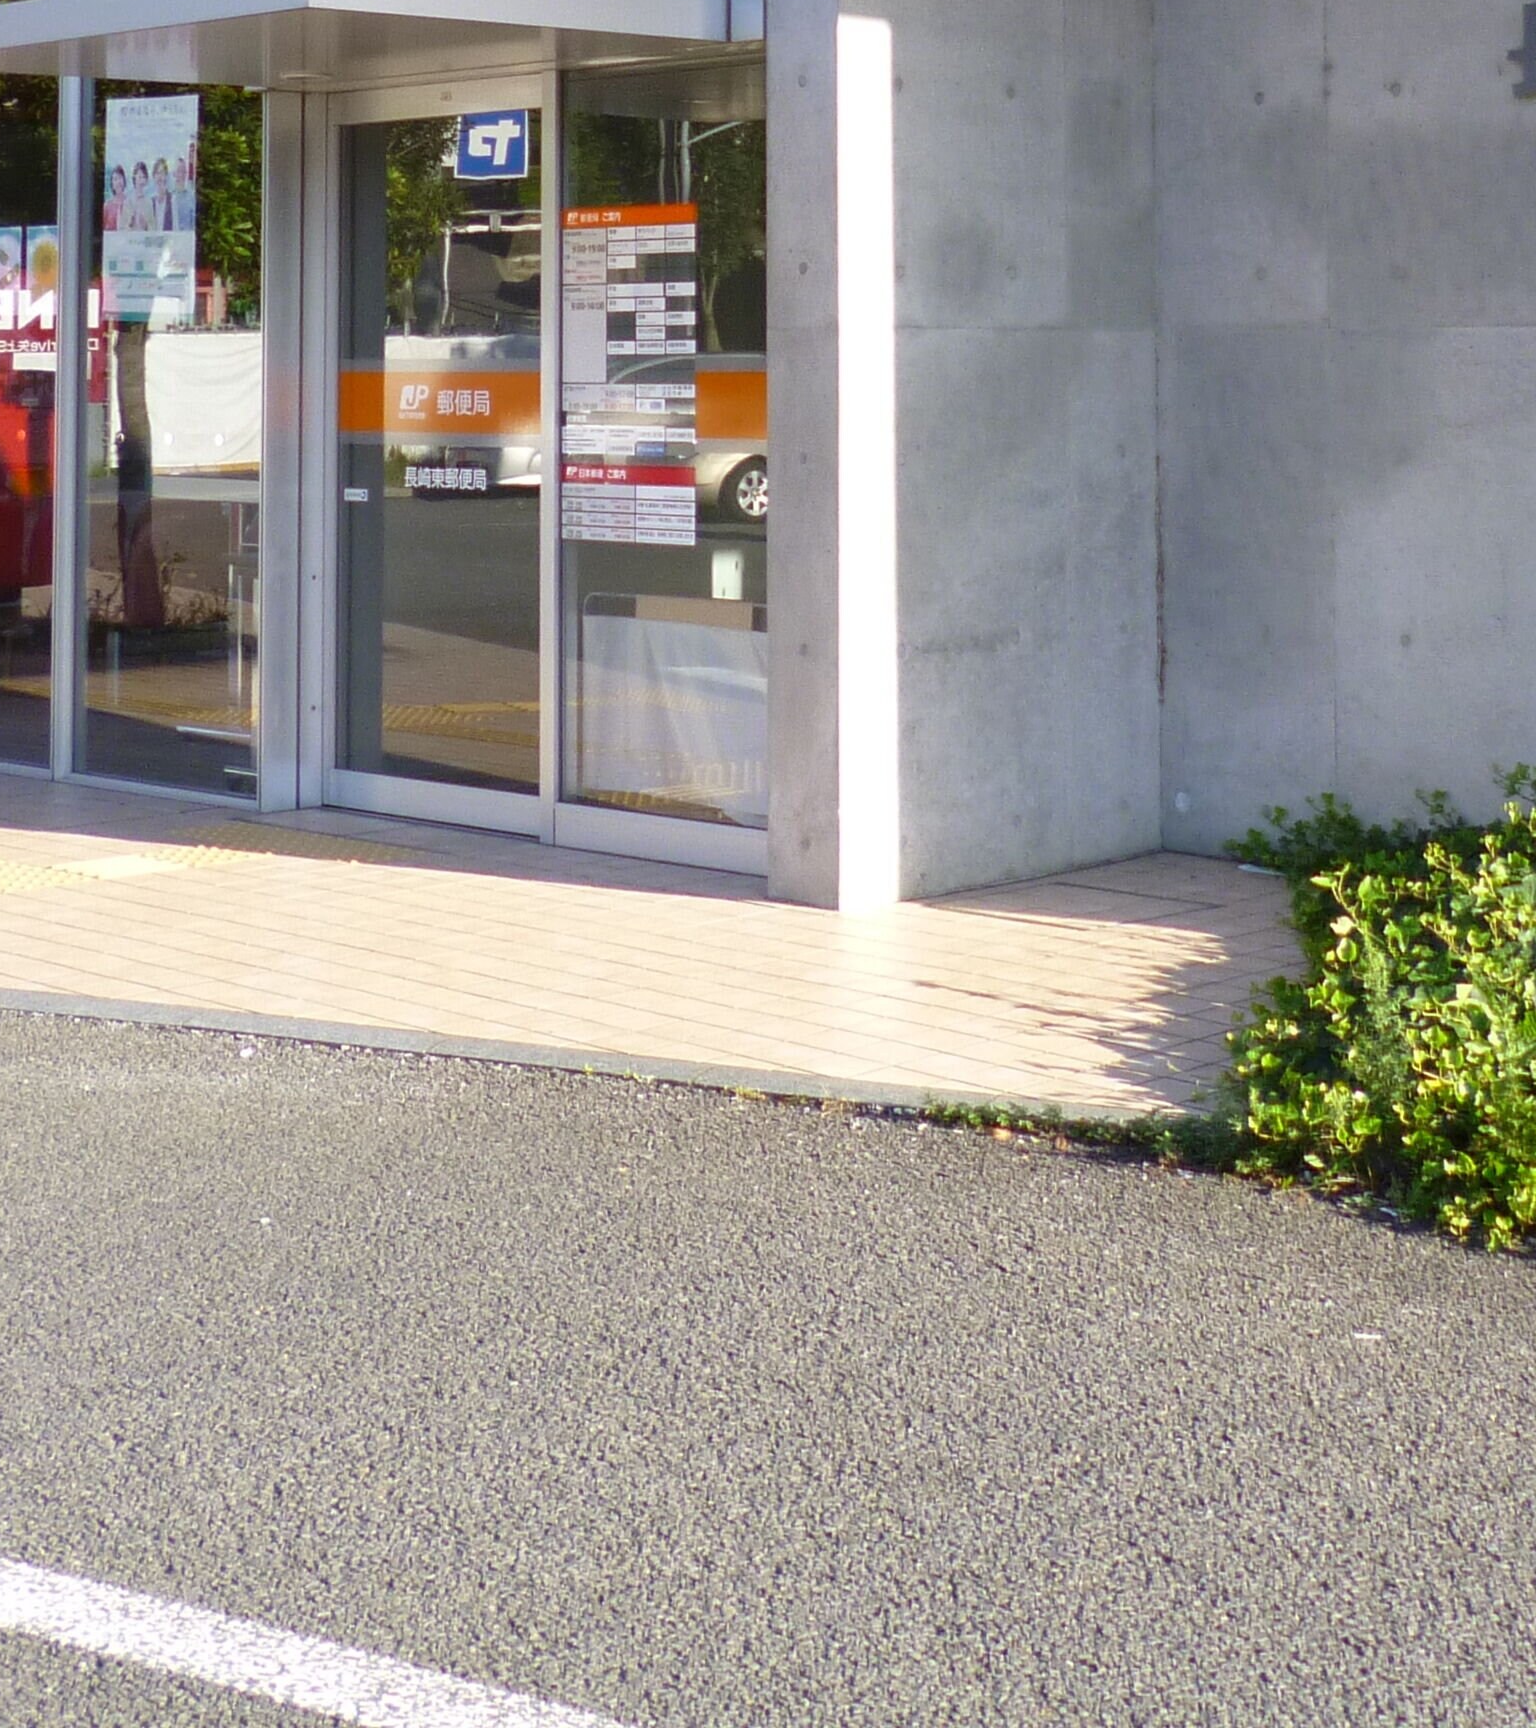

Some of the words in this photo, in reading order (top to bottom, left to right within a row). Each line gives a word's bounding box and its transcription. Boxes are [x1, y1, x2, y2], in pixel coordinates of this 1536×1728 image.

[436, 389, 490, 416] 郵便局
[404, 466, 487, 491] 長崎東郵便局
